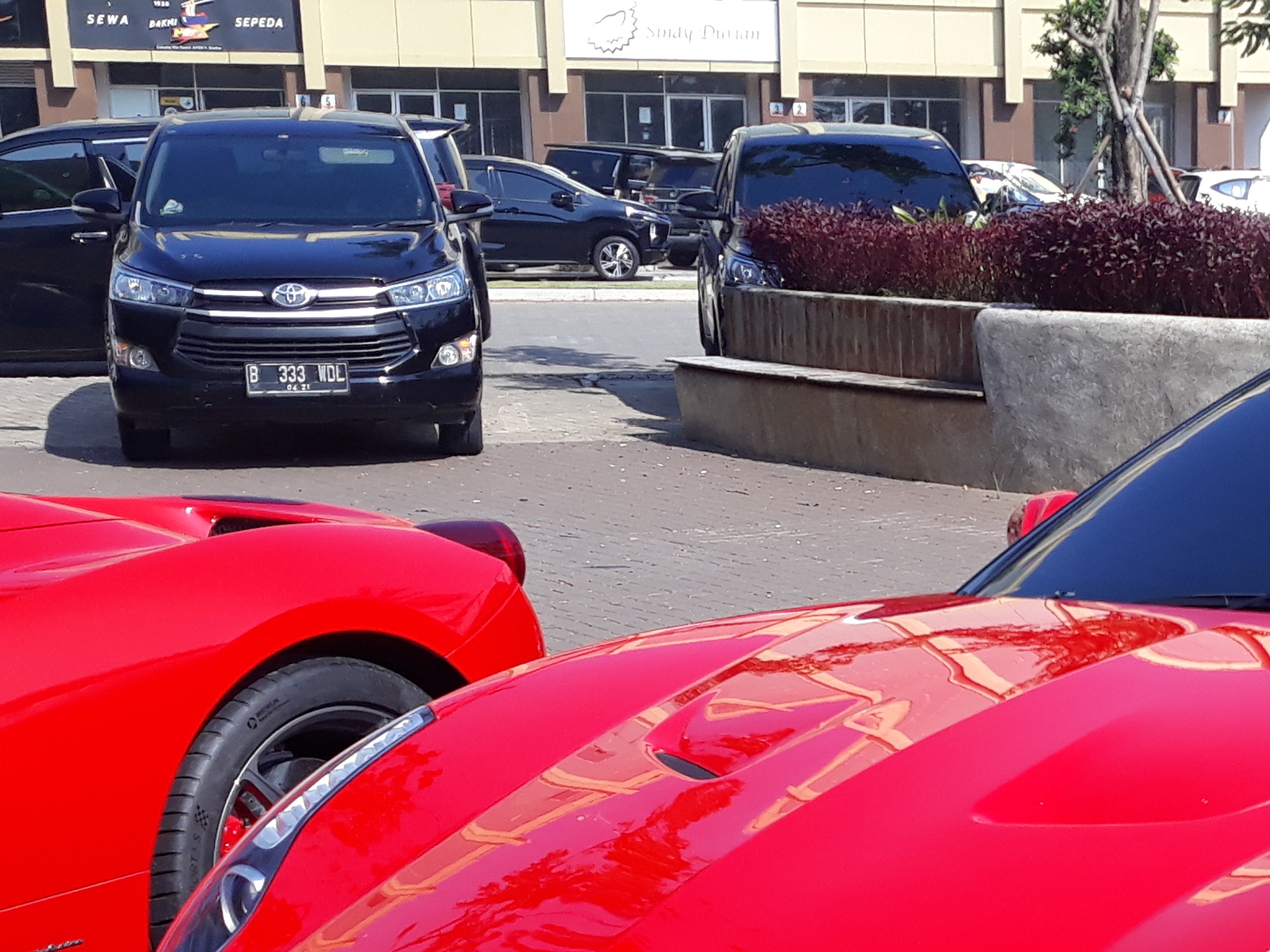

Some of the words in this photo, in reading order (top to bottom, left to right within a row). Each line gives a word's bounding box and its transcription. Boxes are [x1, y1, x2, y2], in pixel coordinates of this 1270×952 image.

[86, 14, 129, 25] SEWA
[234, 17, 284, 28] SEPEDA
[249, 366, 259, 383] B
[279, 365, 306, 383] 333
[318, 364, 346, 383] WDL
